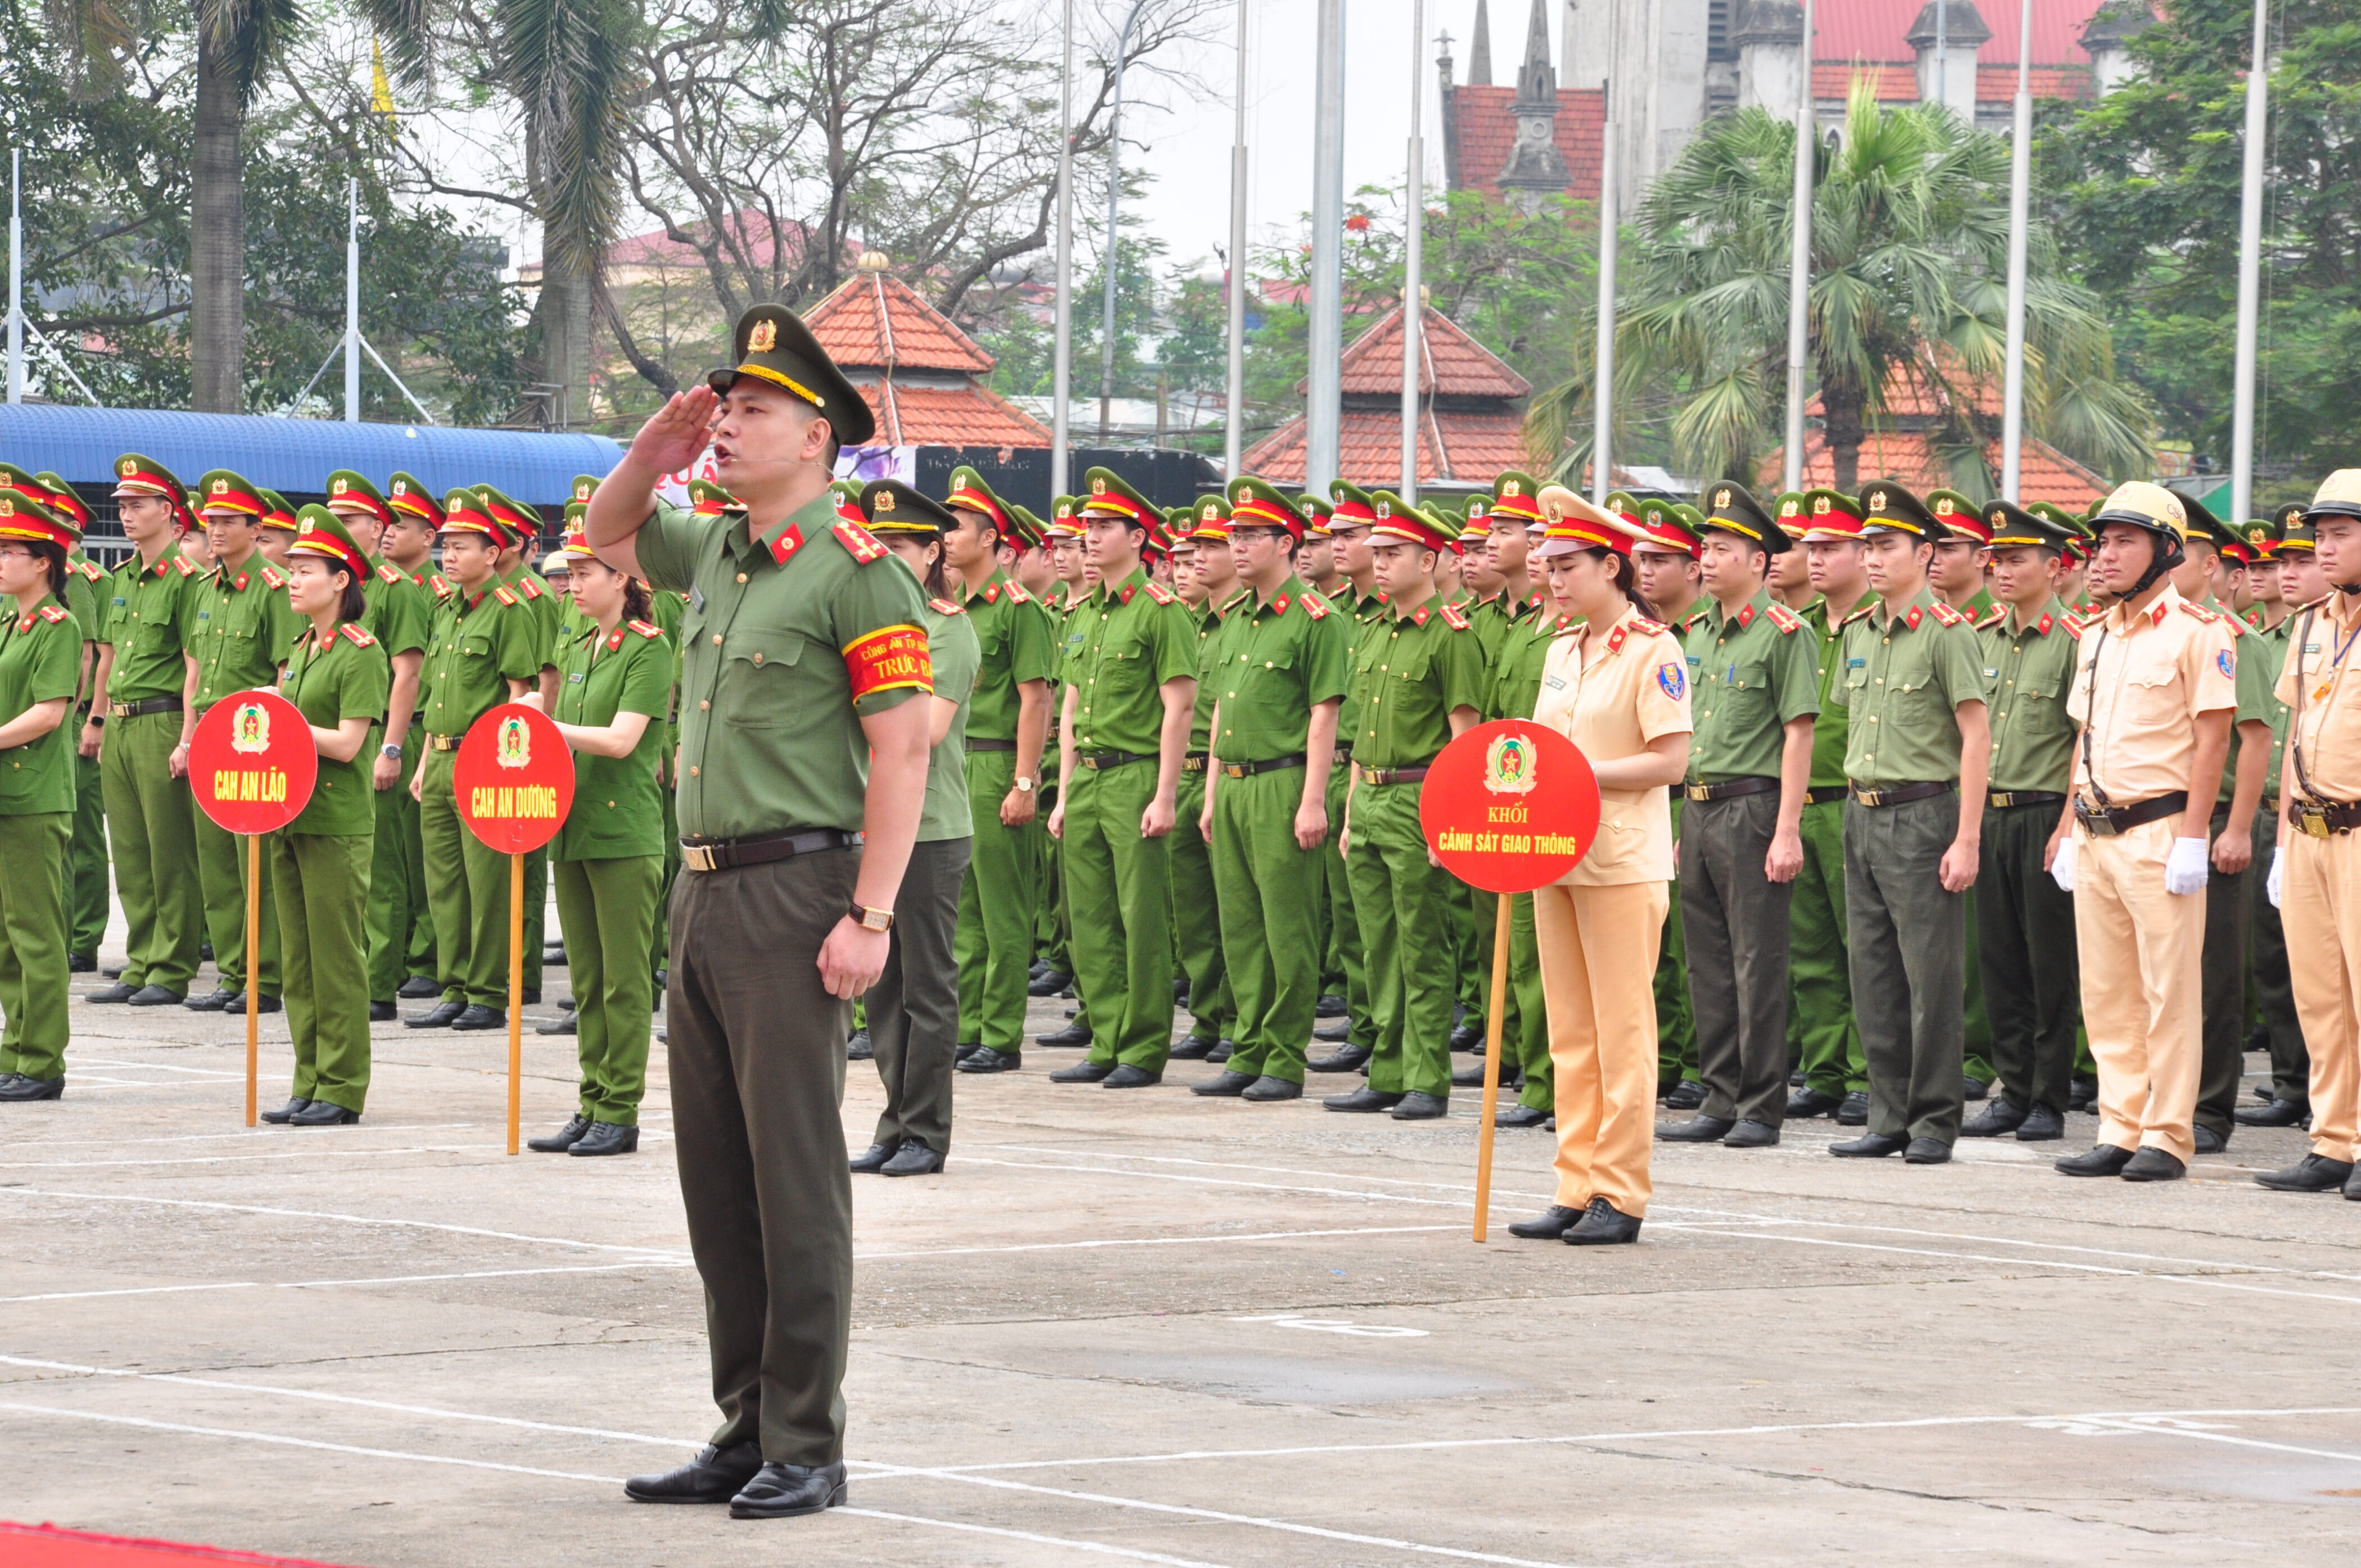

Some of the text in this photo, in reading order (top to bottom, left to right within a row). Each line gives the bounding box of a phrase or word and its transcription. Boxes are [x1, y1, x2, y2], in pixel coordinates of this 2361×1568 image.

[861, 643, 886, 660] CÔNG
[889, 638, 903, 650] AN
[904, 638, 916, 649] TP
[873, 654, 917, 679] TRỰC
[214, 766, 286, 802] CAH AN LÃO
[472, 784, 557, 818] CAH AN DƯƠNG
[1487, 801, 1528, 823] KHỐI
[1439, 827, 1576, 855] CẢNH SÁT GIAO THÔNG
